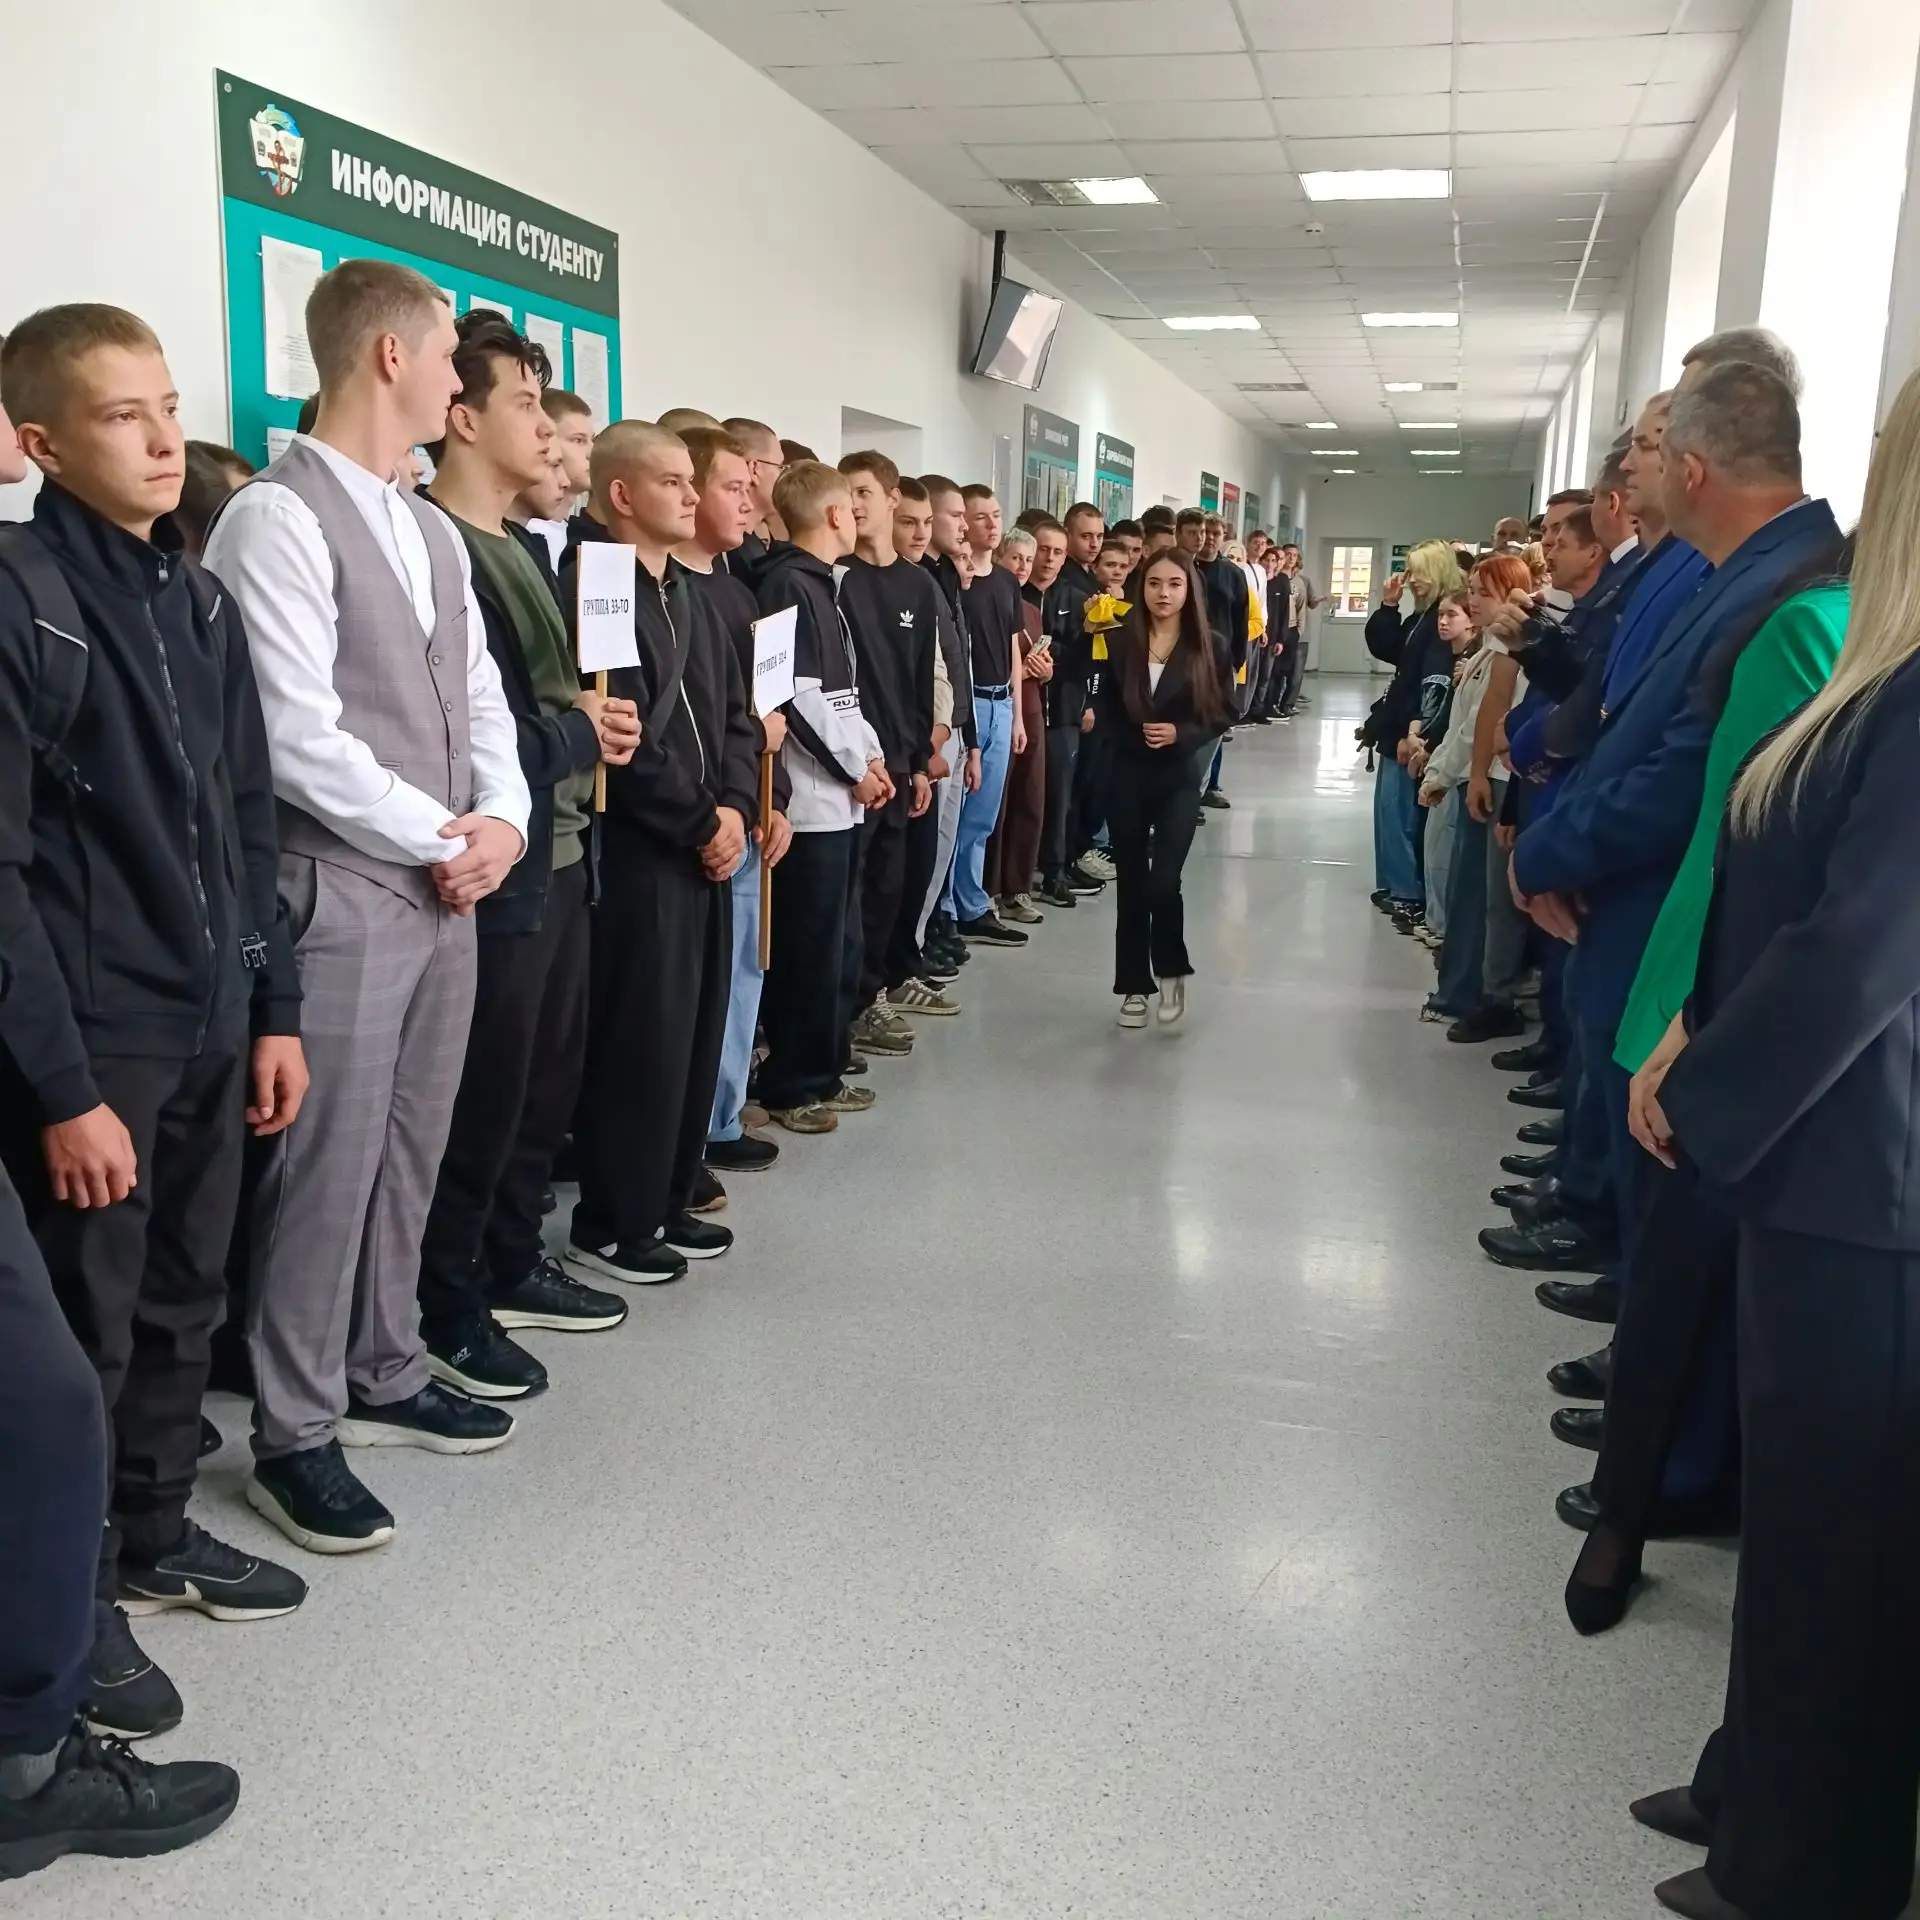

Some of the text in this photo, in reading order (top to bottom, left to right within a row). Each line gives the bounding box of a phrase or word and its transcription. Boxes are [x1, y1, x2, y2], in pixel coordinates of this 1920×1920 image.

[331, 148, 604, 282] ИНФОРМАЦИЯ СТУДЕНТУ
[583, 599, 609, 615] ГРУППА
